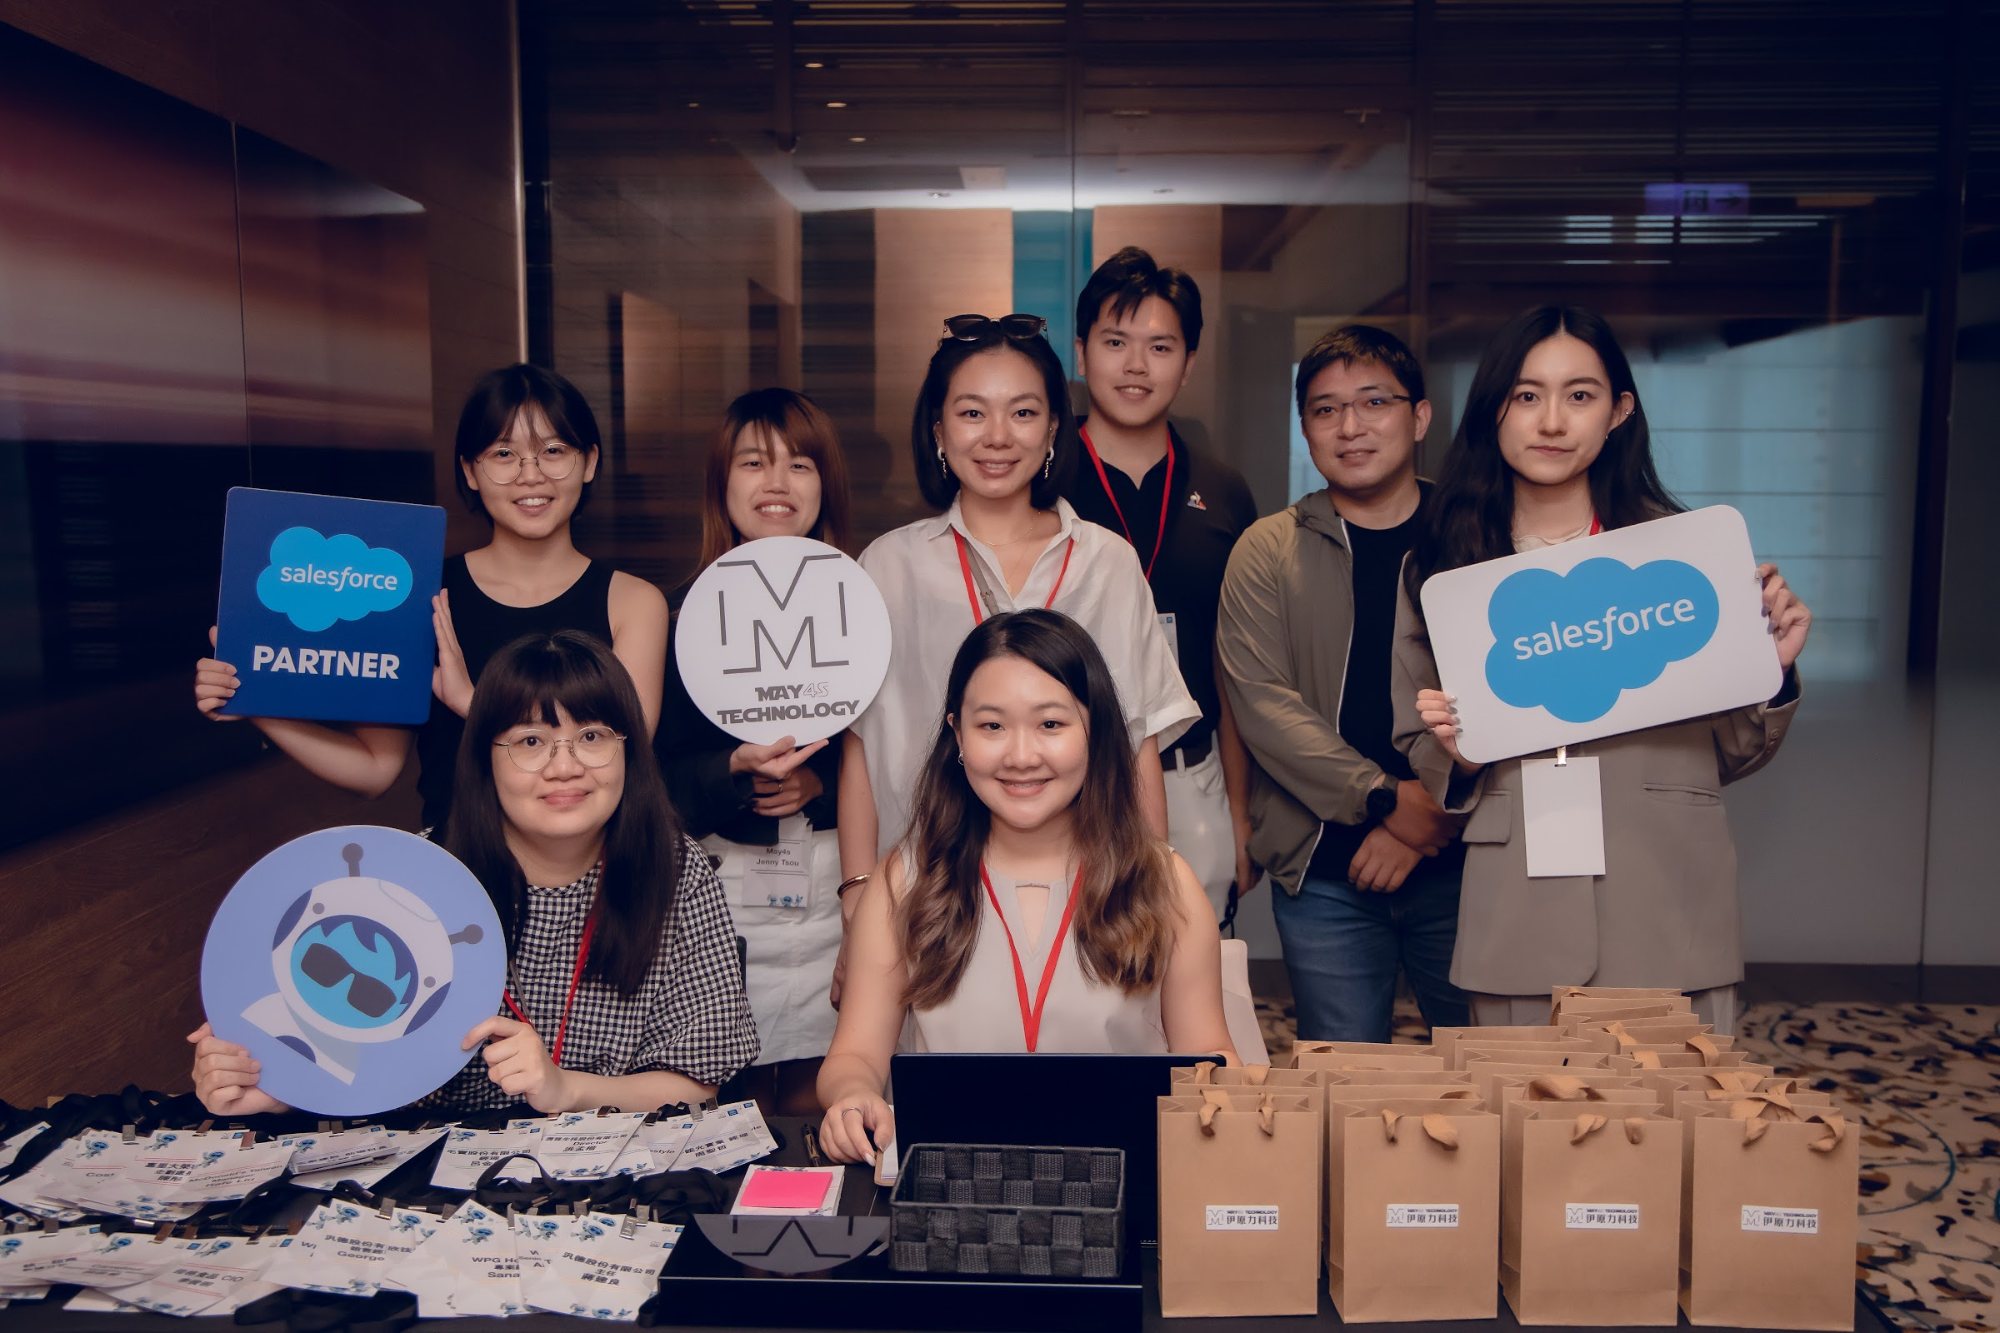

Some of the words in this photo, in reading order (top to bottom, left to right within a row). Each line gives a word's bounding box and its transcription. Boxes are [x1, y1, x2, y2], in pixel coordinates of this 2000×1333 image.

[280, 563, 398, 592] salesforce
[1513, 598, 1696, 661] salesforce
[253, 645, 400, 680] PARTNER
[717, 700, 861, 725] TECHNOLOGY
[1226, 1215, 1277, 1225] 伊原力科技
[1406, 1213, 1457, 1223] 伊原力科技
[1586, 1213, 1638, 1224] 伊原力科技
[1763, 1216, 1817, 1228] 伊原力科技
[337, 1250, 385, 1262] George
